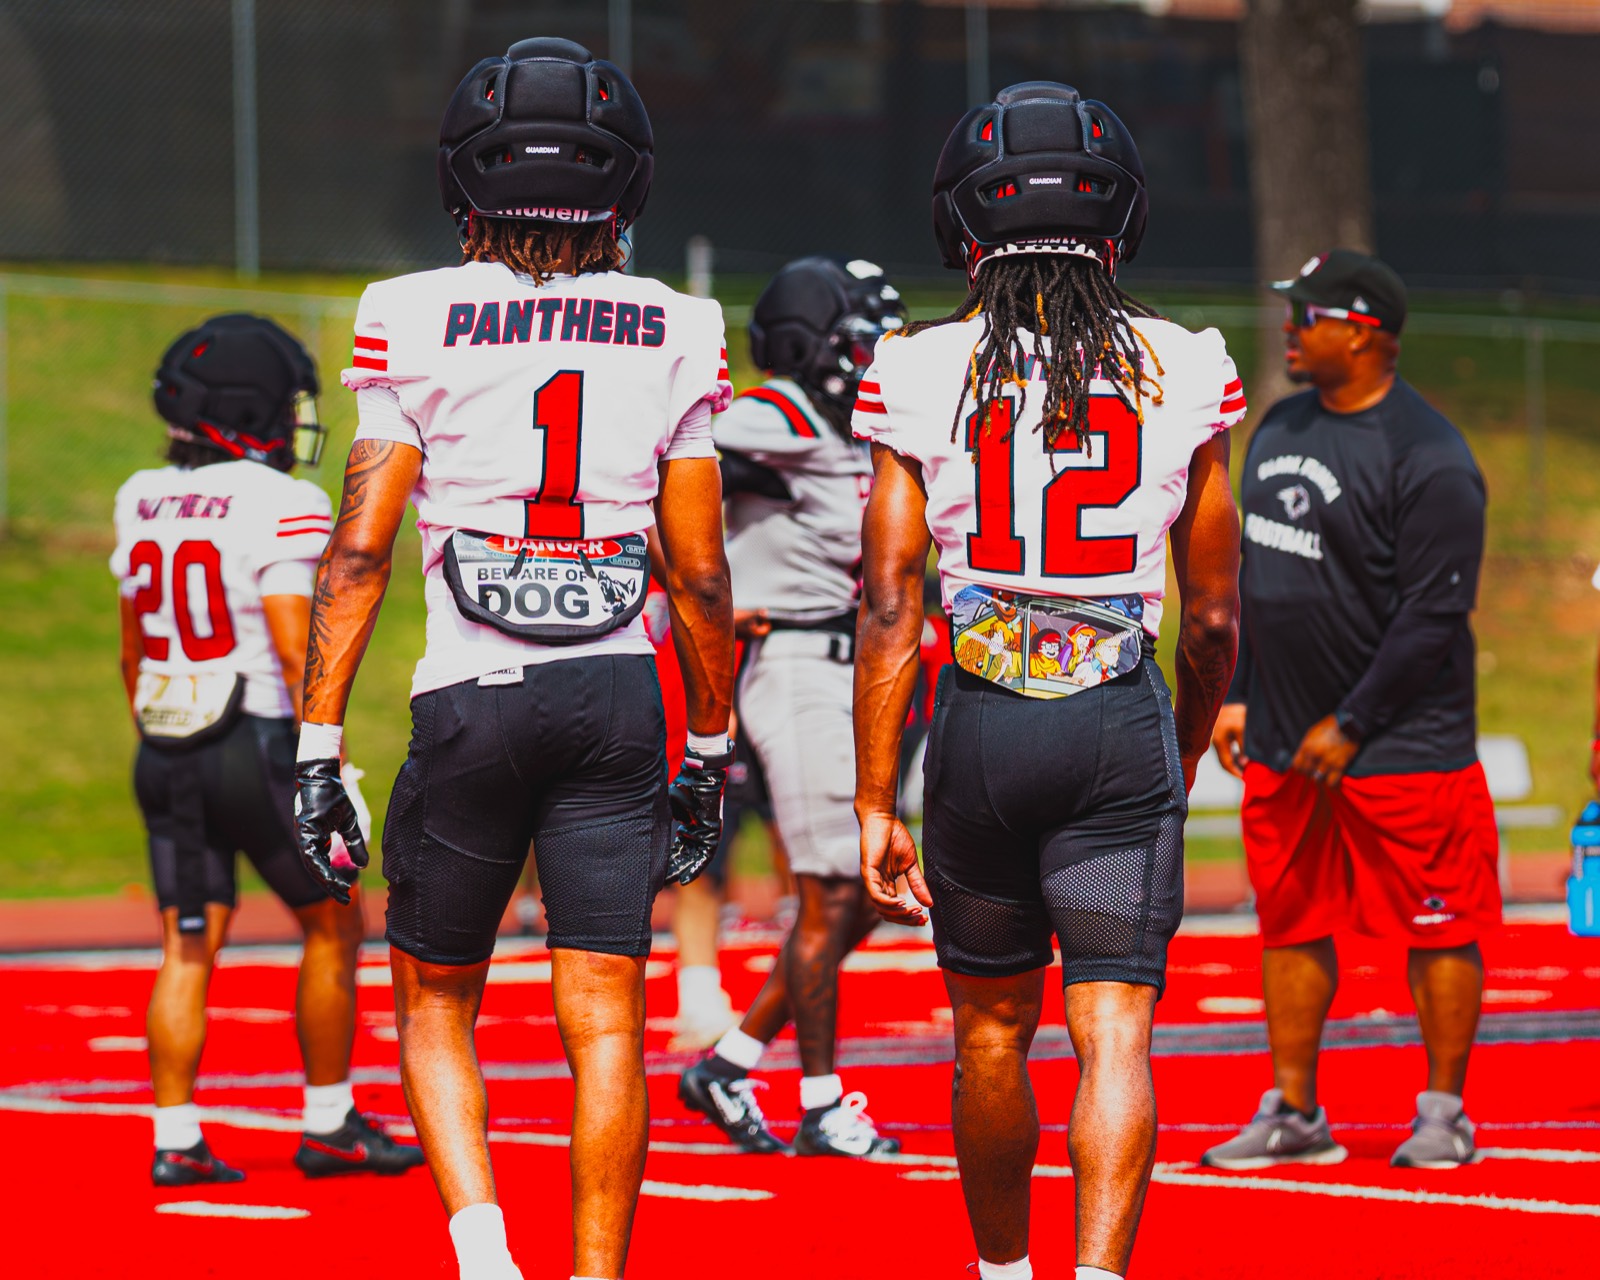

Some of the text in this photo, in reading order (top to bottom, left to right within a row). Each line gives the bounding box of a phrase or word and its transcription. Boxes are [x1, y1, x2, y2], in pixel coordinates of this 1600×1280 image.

[525, 146, 560, 154] GUARDIAN
[1029, 177, 1062, 185] GUARDIAN
[443, 297, 666, 348] PANTHERS
[523, 369, 585, 540] 1
[964, 393, 1143, 578] 12
[503, 537, 606, 556] DANGER
[477, 567, 588, 582] BEWARE OF
[612, 557, 638, 566] BATTLE
[129, 539, 237, 662] 20
[477, 582, 590, 619] DOG
